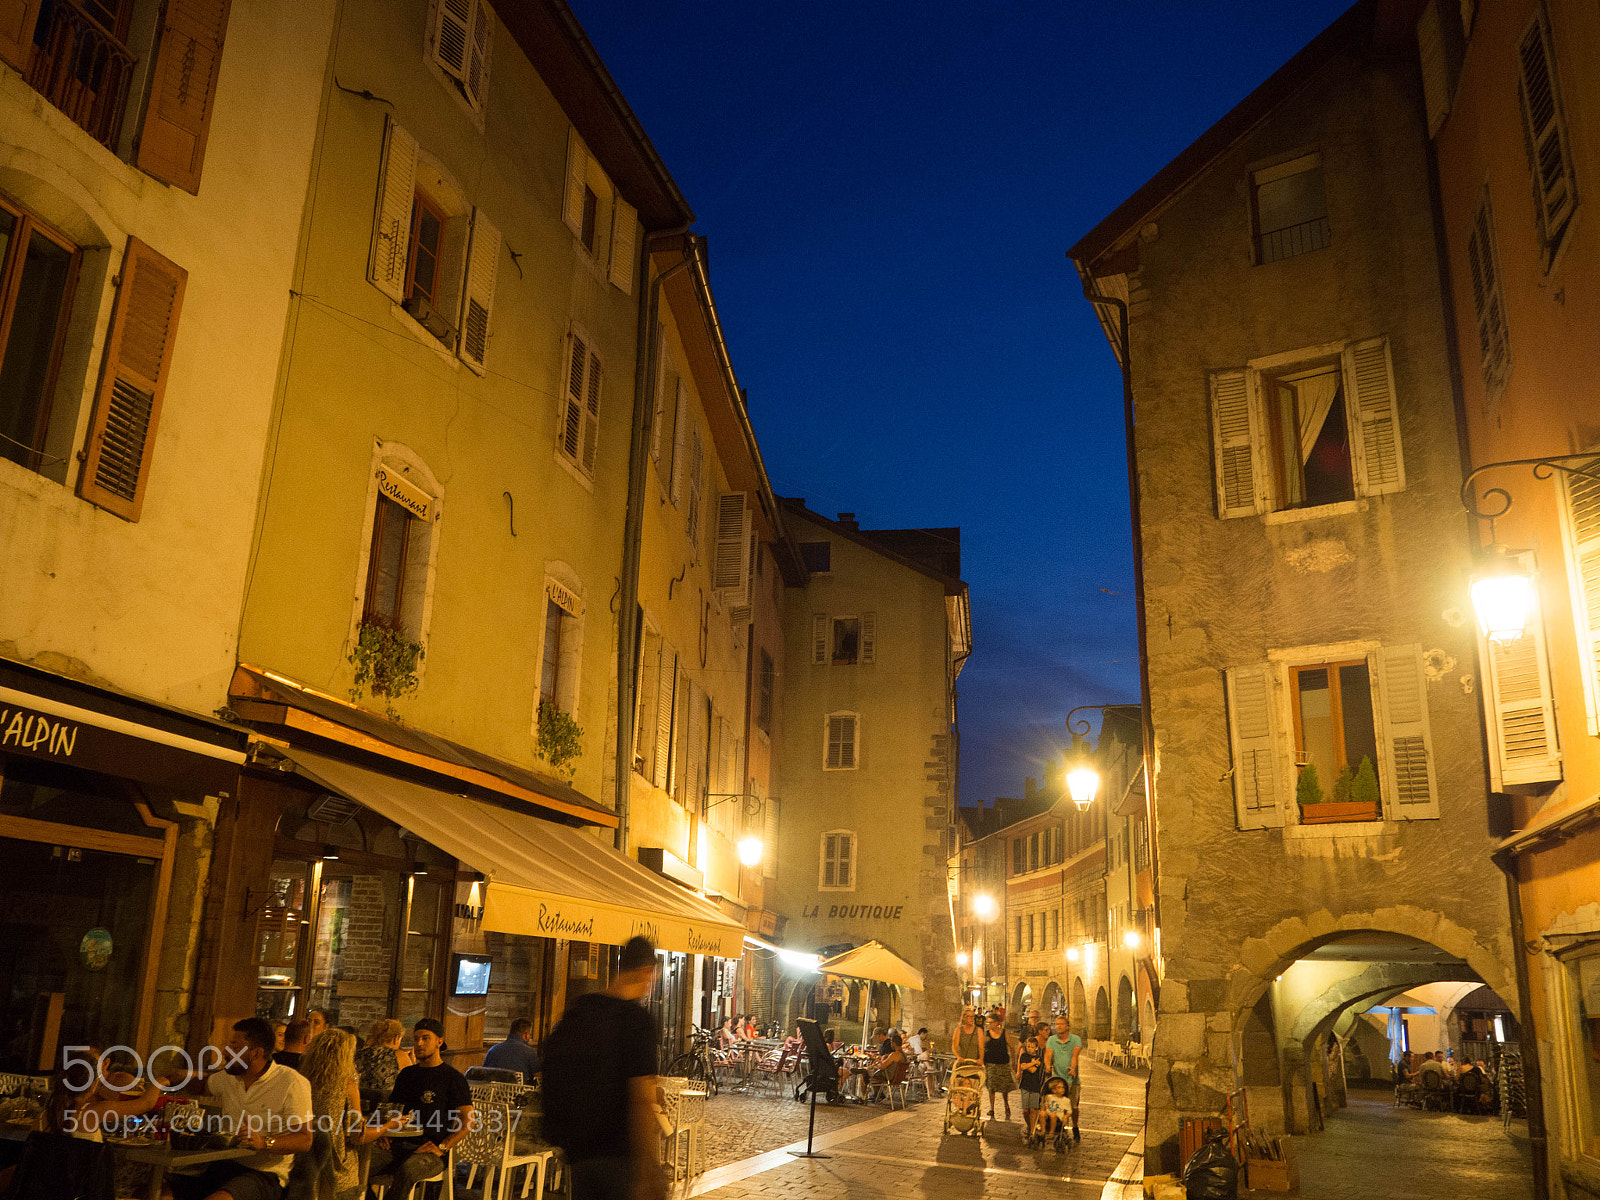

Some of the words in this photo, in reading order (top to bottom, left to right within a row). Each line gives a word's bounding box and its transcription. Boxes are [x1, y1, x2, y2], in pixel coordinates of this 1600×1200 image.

[380, 470, 428, 517] Restaurant
[537, 902, 594, 938] Restaurant
[802, 904, 820, 919] LA
[828, 904, 904, 919] BOUTIQUE
